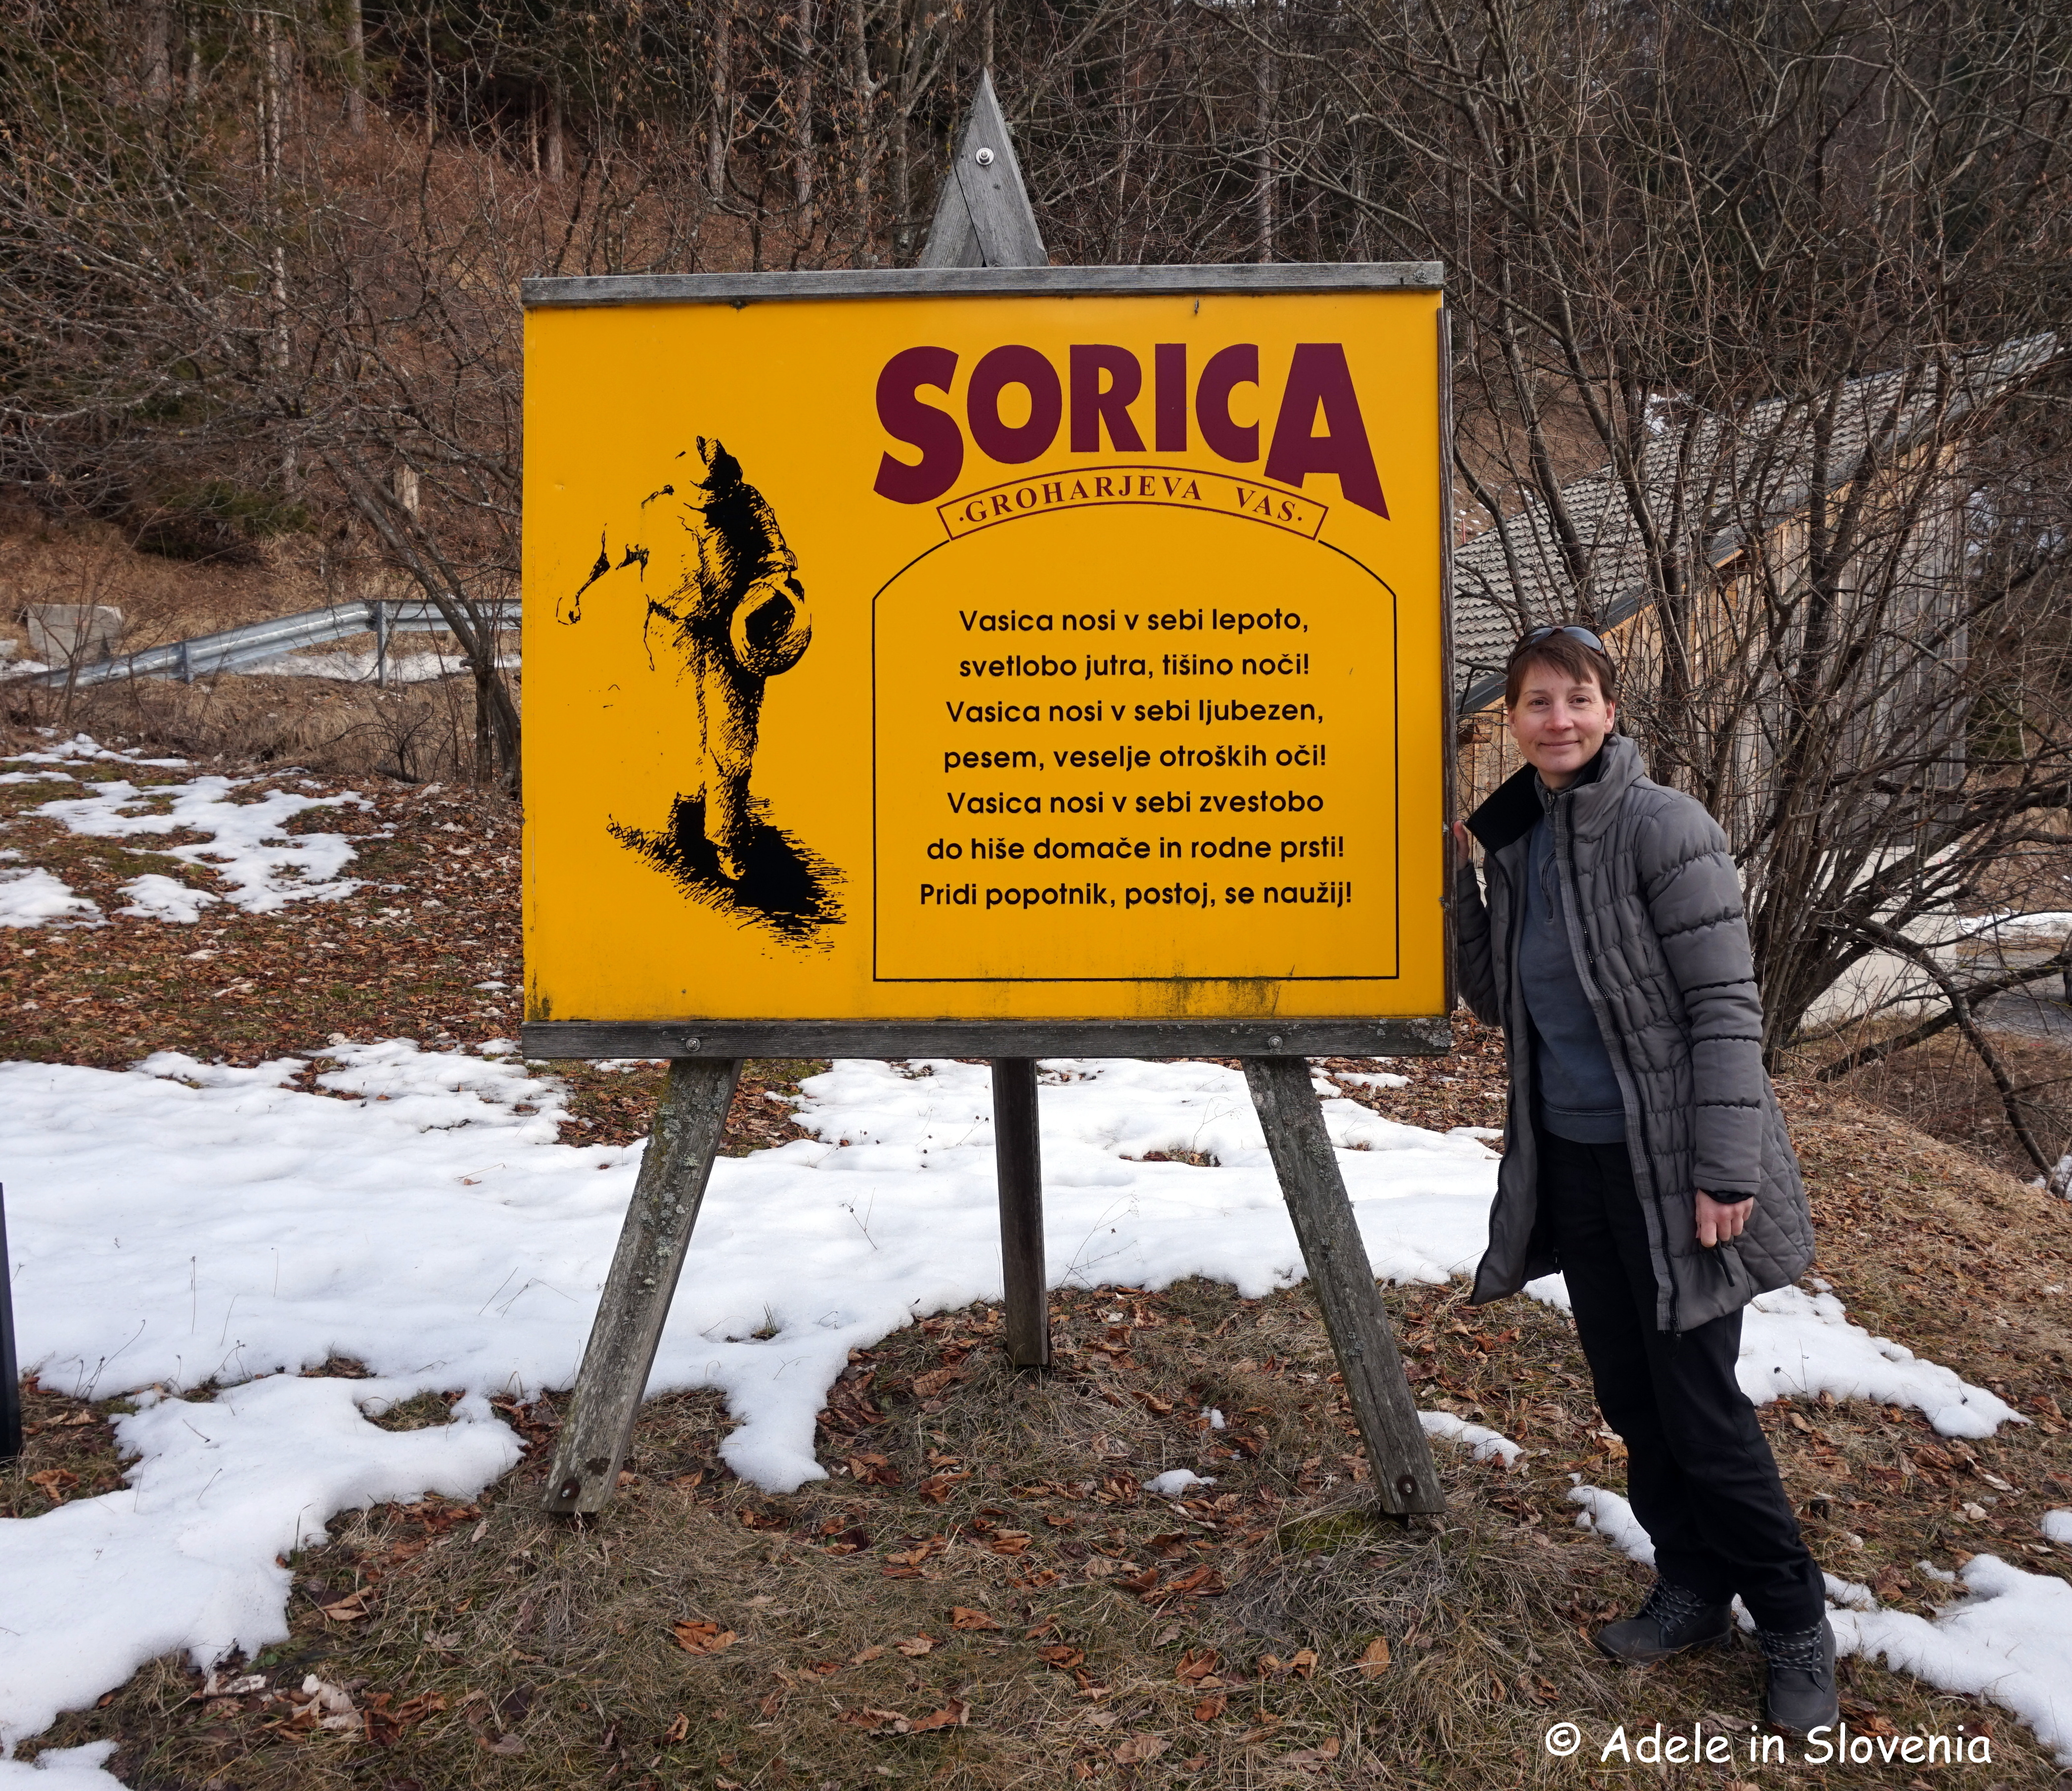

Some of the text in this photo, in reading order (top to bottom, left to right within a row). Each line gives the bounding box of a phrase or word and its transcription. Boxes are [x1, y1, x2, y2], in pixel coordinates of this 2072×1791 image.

[873, 343, 1390, 521] SORICA
[959, 608, 1307, 635] Vasica nosi v sebi lepoto,
[960, 653, 1308, 681] svetlobo jutra, tišino noči!
[946, 699, 1323, 726] Vasica nosi v sebi ljubezen,
[945, 744, 1325, 773] pesem, veselje otroških oči!
[947, 790, 1323, 814] Vasica nosi v sebi zvestobo
[927, 836, 1343, 863] do hiše domače in rodne prsti!
[921, 881, 1351, 910] Pridi popotnik, postoj, se naužij!
